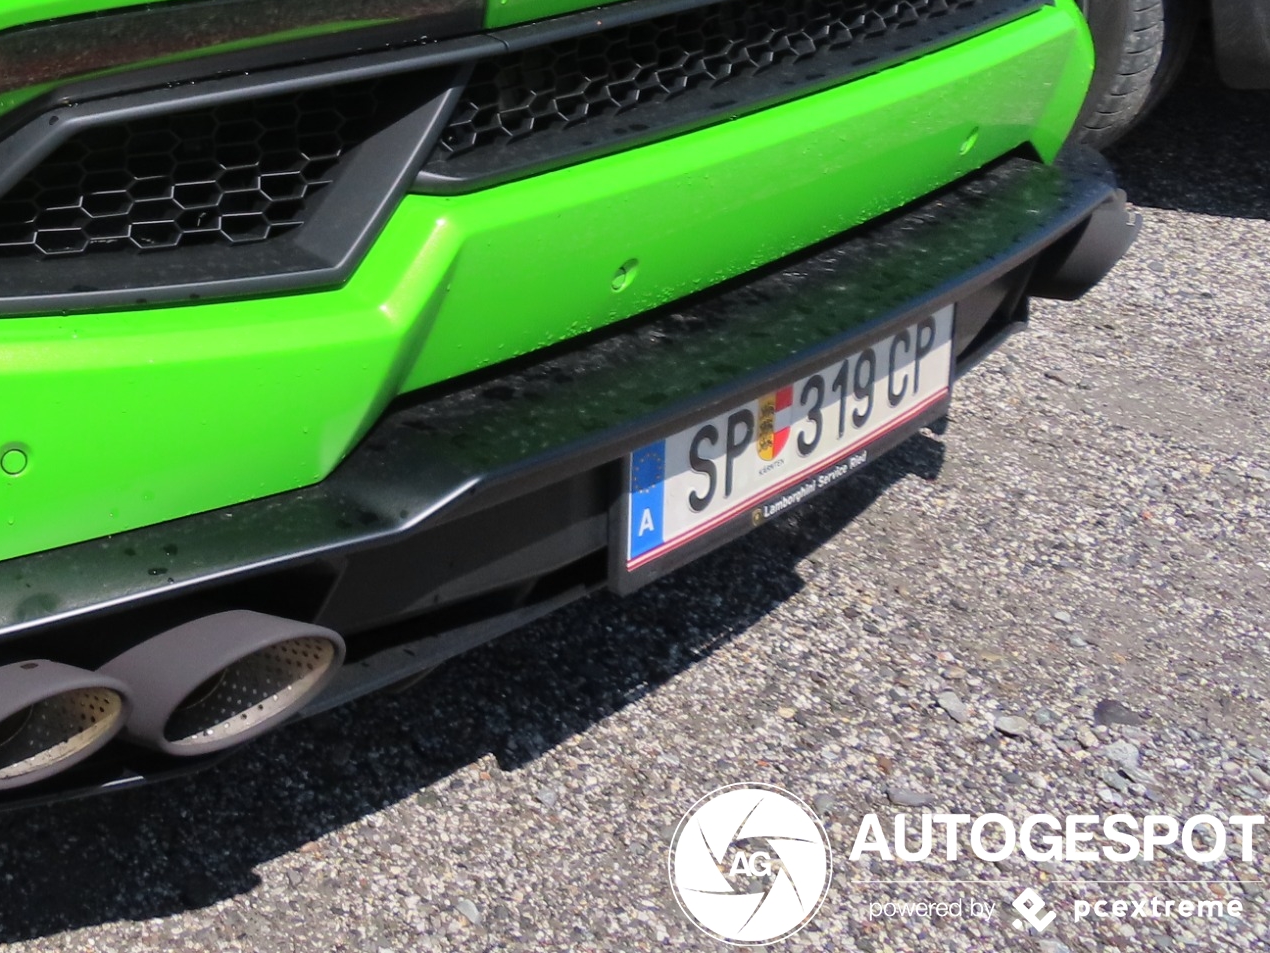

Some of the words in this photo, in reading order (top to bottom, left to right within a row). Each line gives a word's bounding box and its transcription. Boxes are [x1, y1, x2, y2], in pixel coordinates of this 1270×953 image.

[688, 409, 755, 512] SP
[797, 348, 877, 456] 319
[888, 315, 936, 407] CP
[763, 479, 816, 517] Lamborghini
[817, 463, 848, 488] Service
[638, 507, 656, 538] A
